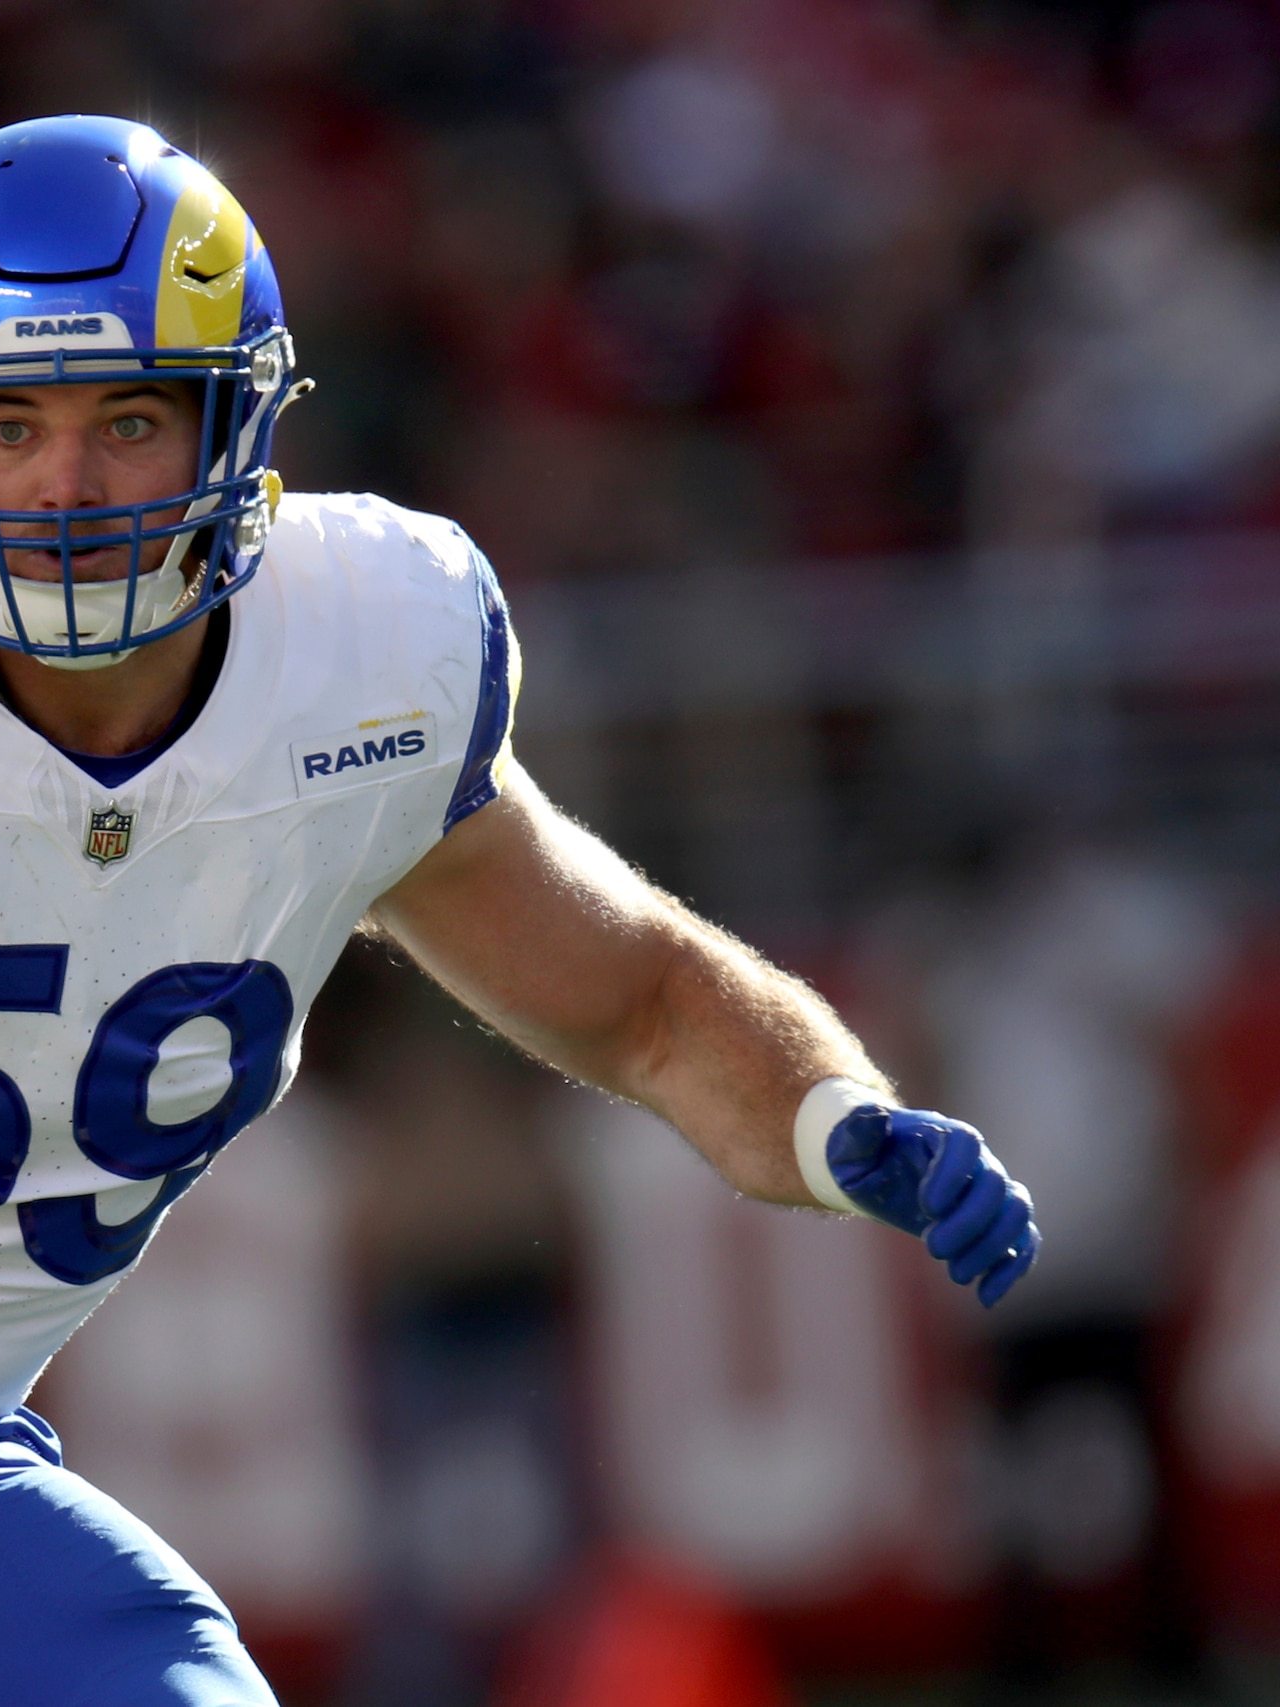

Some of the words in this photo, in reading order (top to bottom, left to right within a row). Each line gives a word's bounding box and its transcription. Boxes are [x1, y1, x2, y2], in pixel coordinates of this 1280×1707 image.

[15, 317, 103, 338] RAMS
[303, 730, 425, 779] RAMS
[91, 831, 124, 857] NFL
